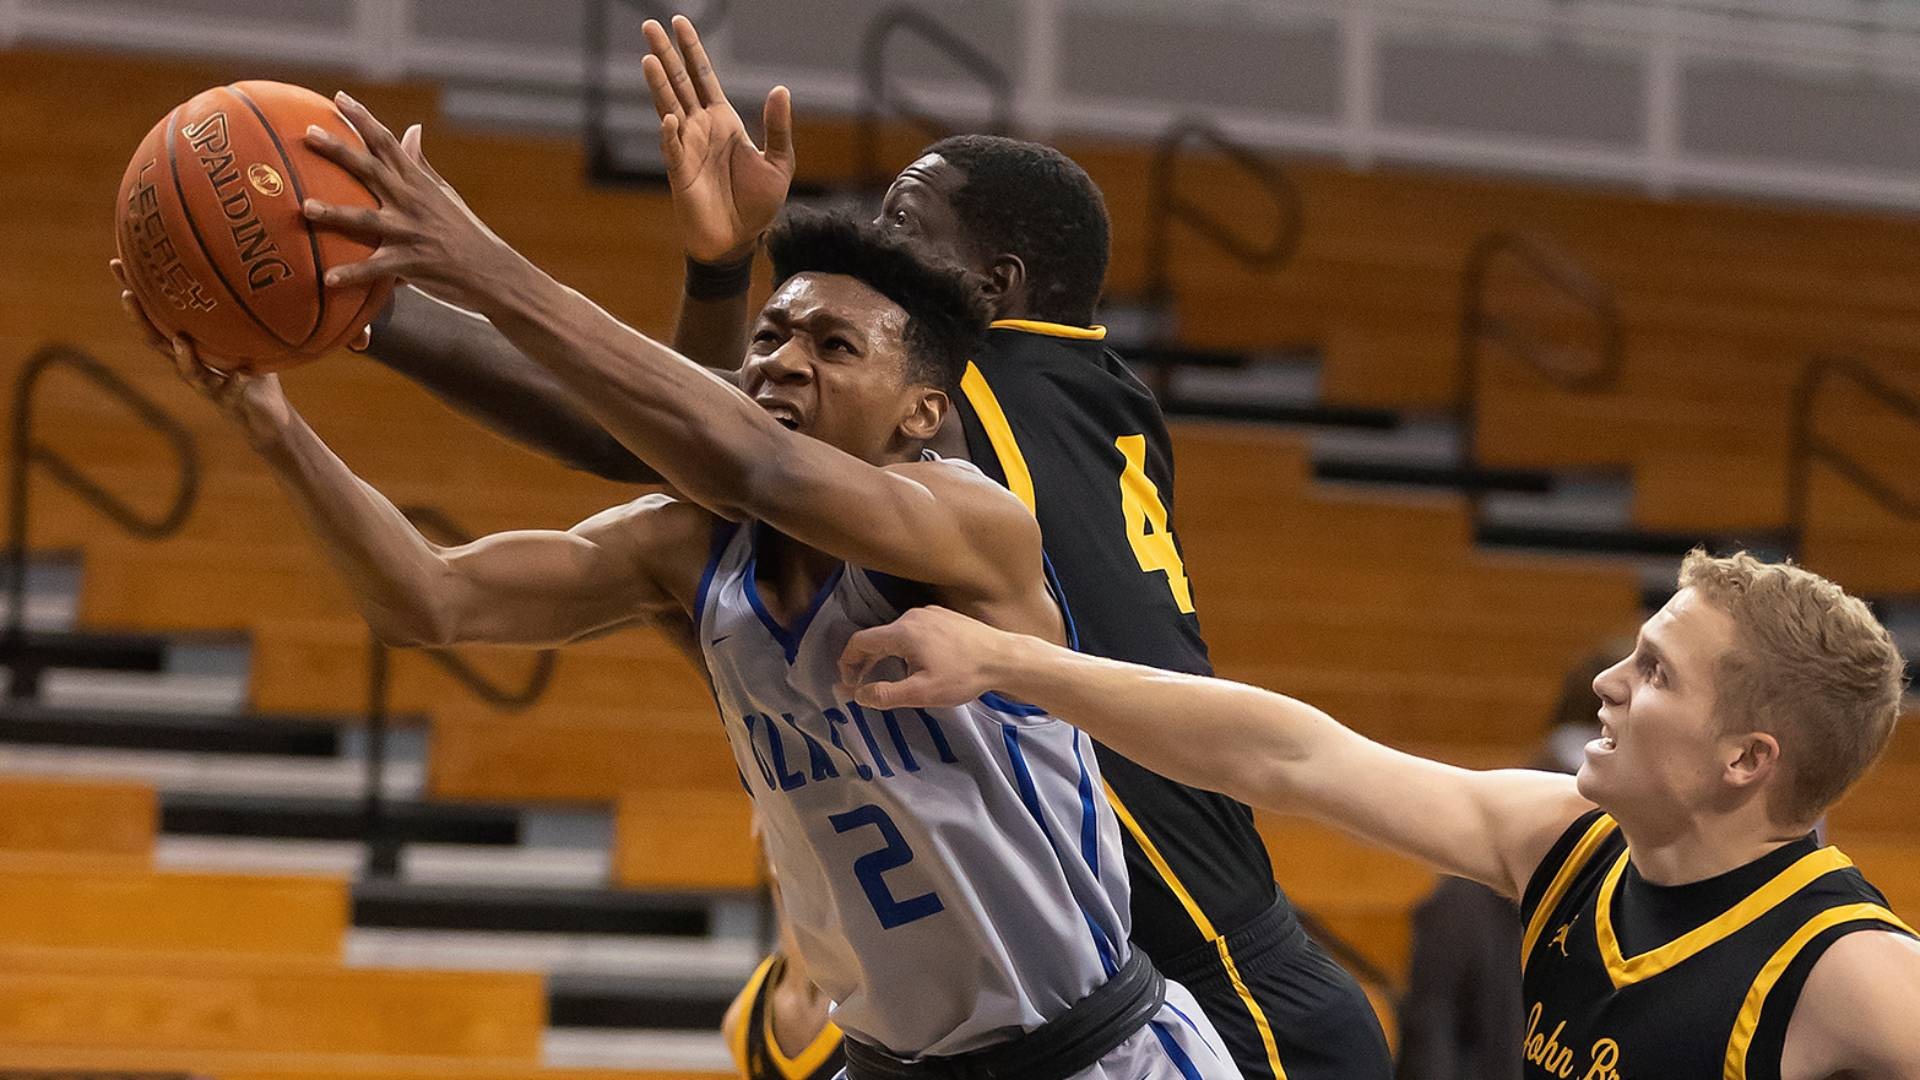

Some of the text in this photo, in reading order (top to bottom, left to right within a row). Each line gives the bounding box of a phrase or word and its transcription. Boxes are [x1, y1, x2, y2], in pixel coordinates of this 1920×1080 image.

[182, 111, 294, 294] SPALDING
[1114, 433, 1196, 614] 4
[828, 804, 945, 930] 2
[1523, 1001, 1574, 1079] John
